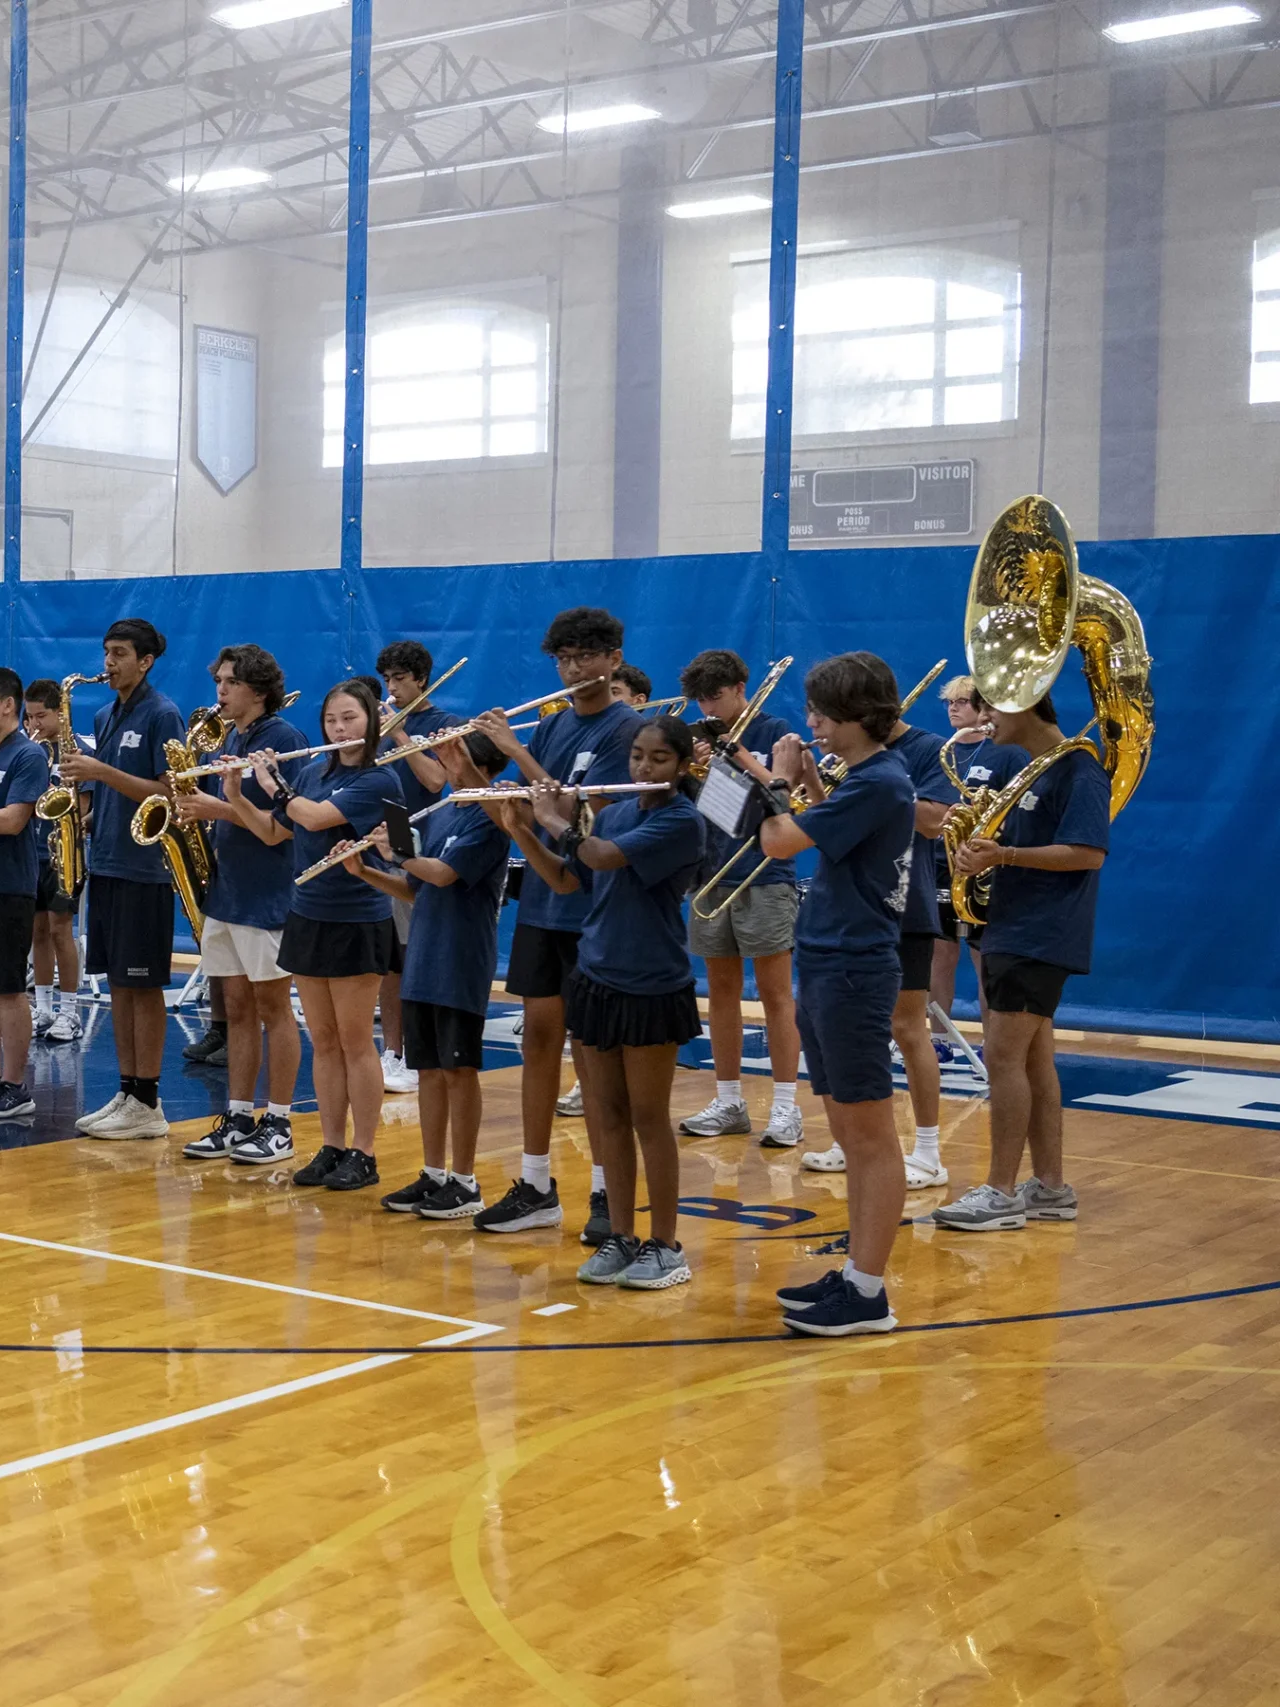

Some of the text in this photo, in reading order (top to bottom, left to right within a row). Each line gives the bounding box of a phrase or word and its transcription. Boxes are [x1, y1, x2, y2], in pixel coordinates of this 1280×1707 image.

[919, 465, 970, 481] VISITOR
[844, 507, 863, 516] POSS
[837, 515, 870, 527] PERIOD
[914, 519, 945, 530] BONUS
